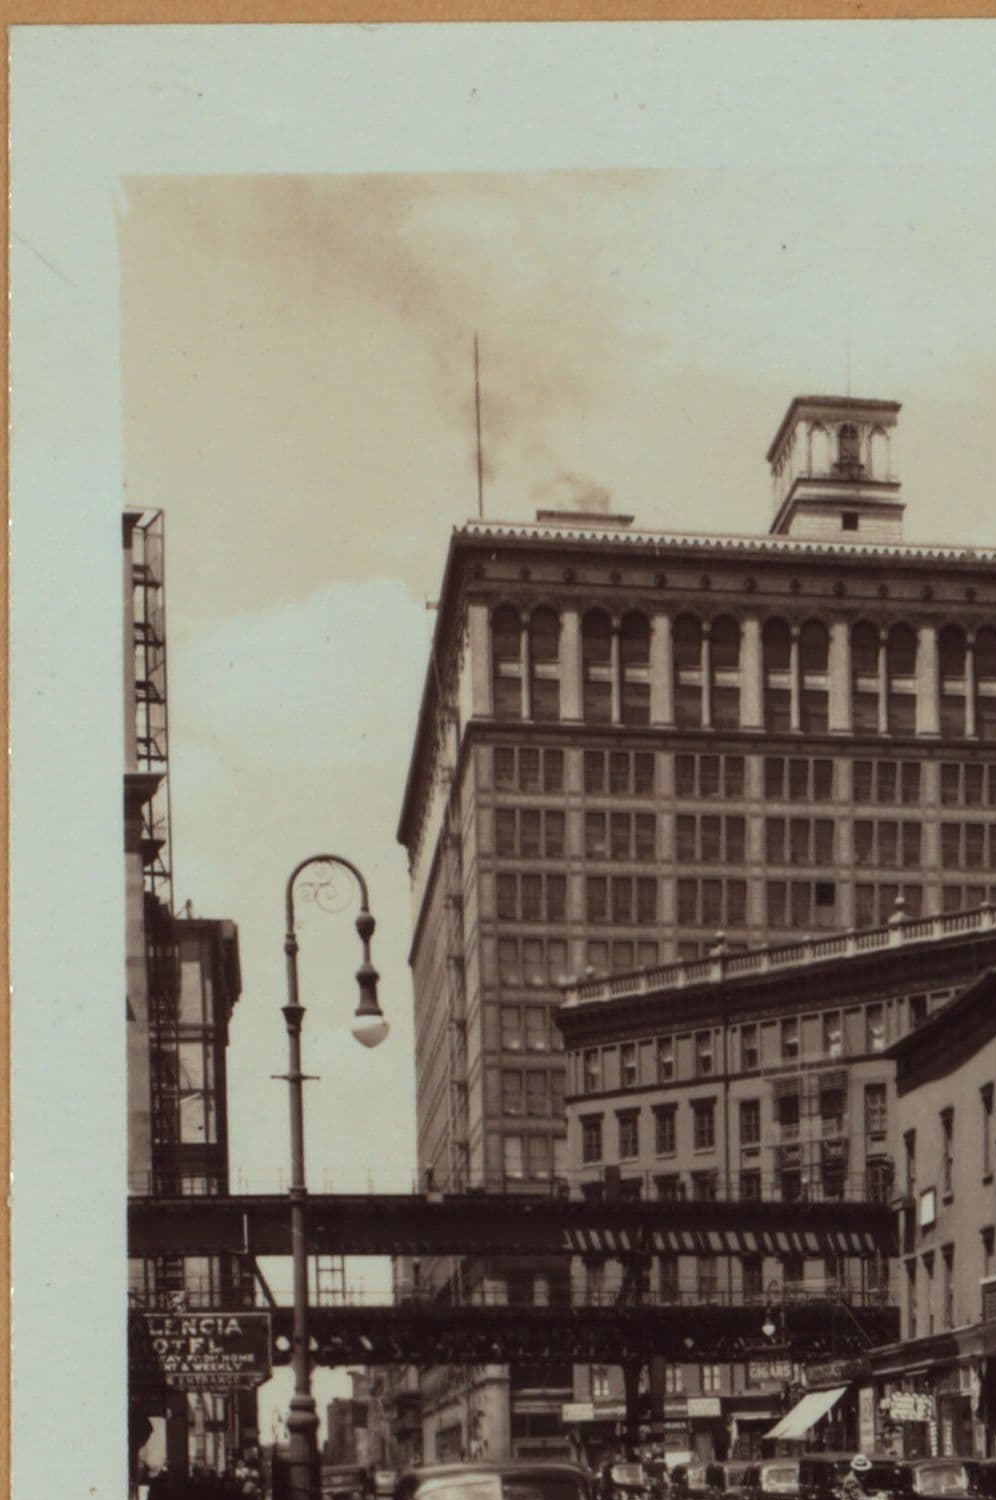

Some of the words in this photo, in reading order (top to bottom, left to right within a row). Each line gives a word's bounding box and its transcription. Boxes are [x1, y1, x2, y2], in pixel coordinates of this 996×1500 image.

[149, 1318, 242, 1336] LENCIA
[153, 1337, 224, 1355] OTEL
[222, 1353, 255, 1363] HOME
